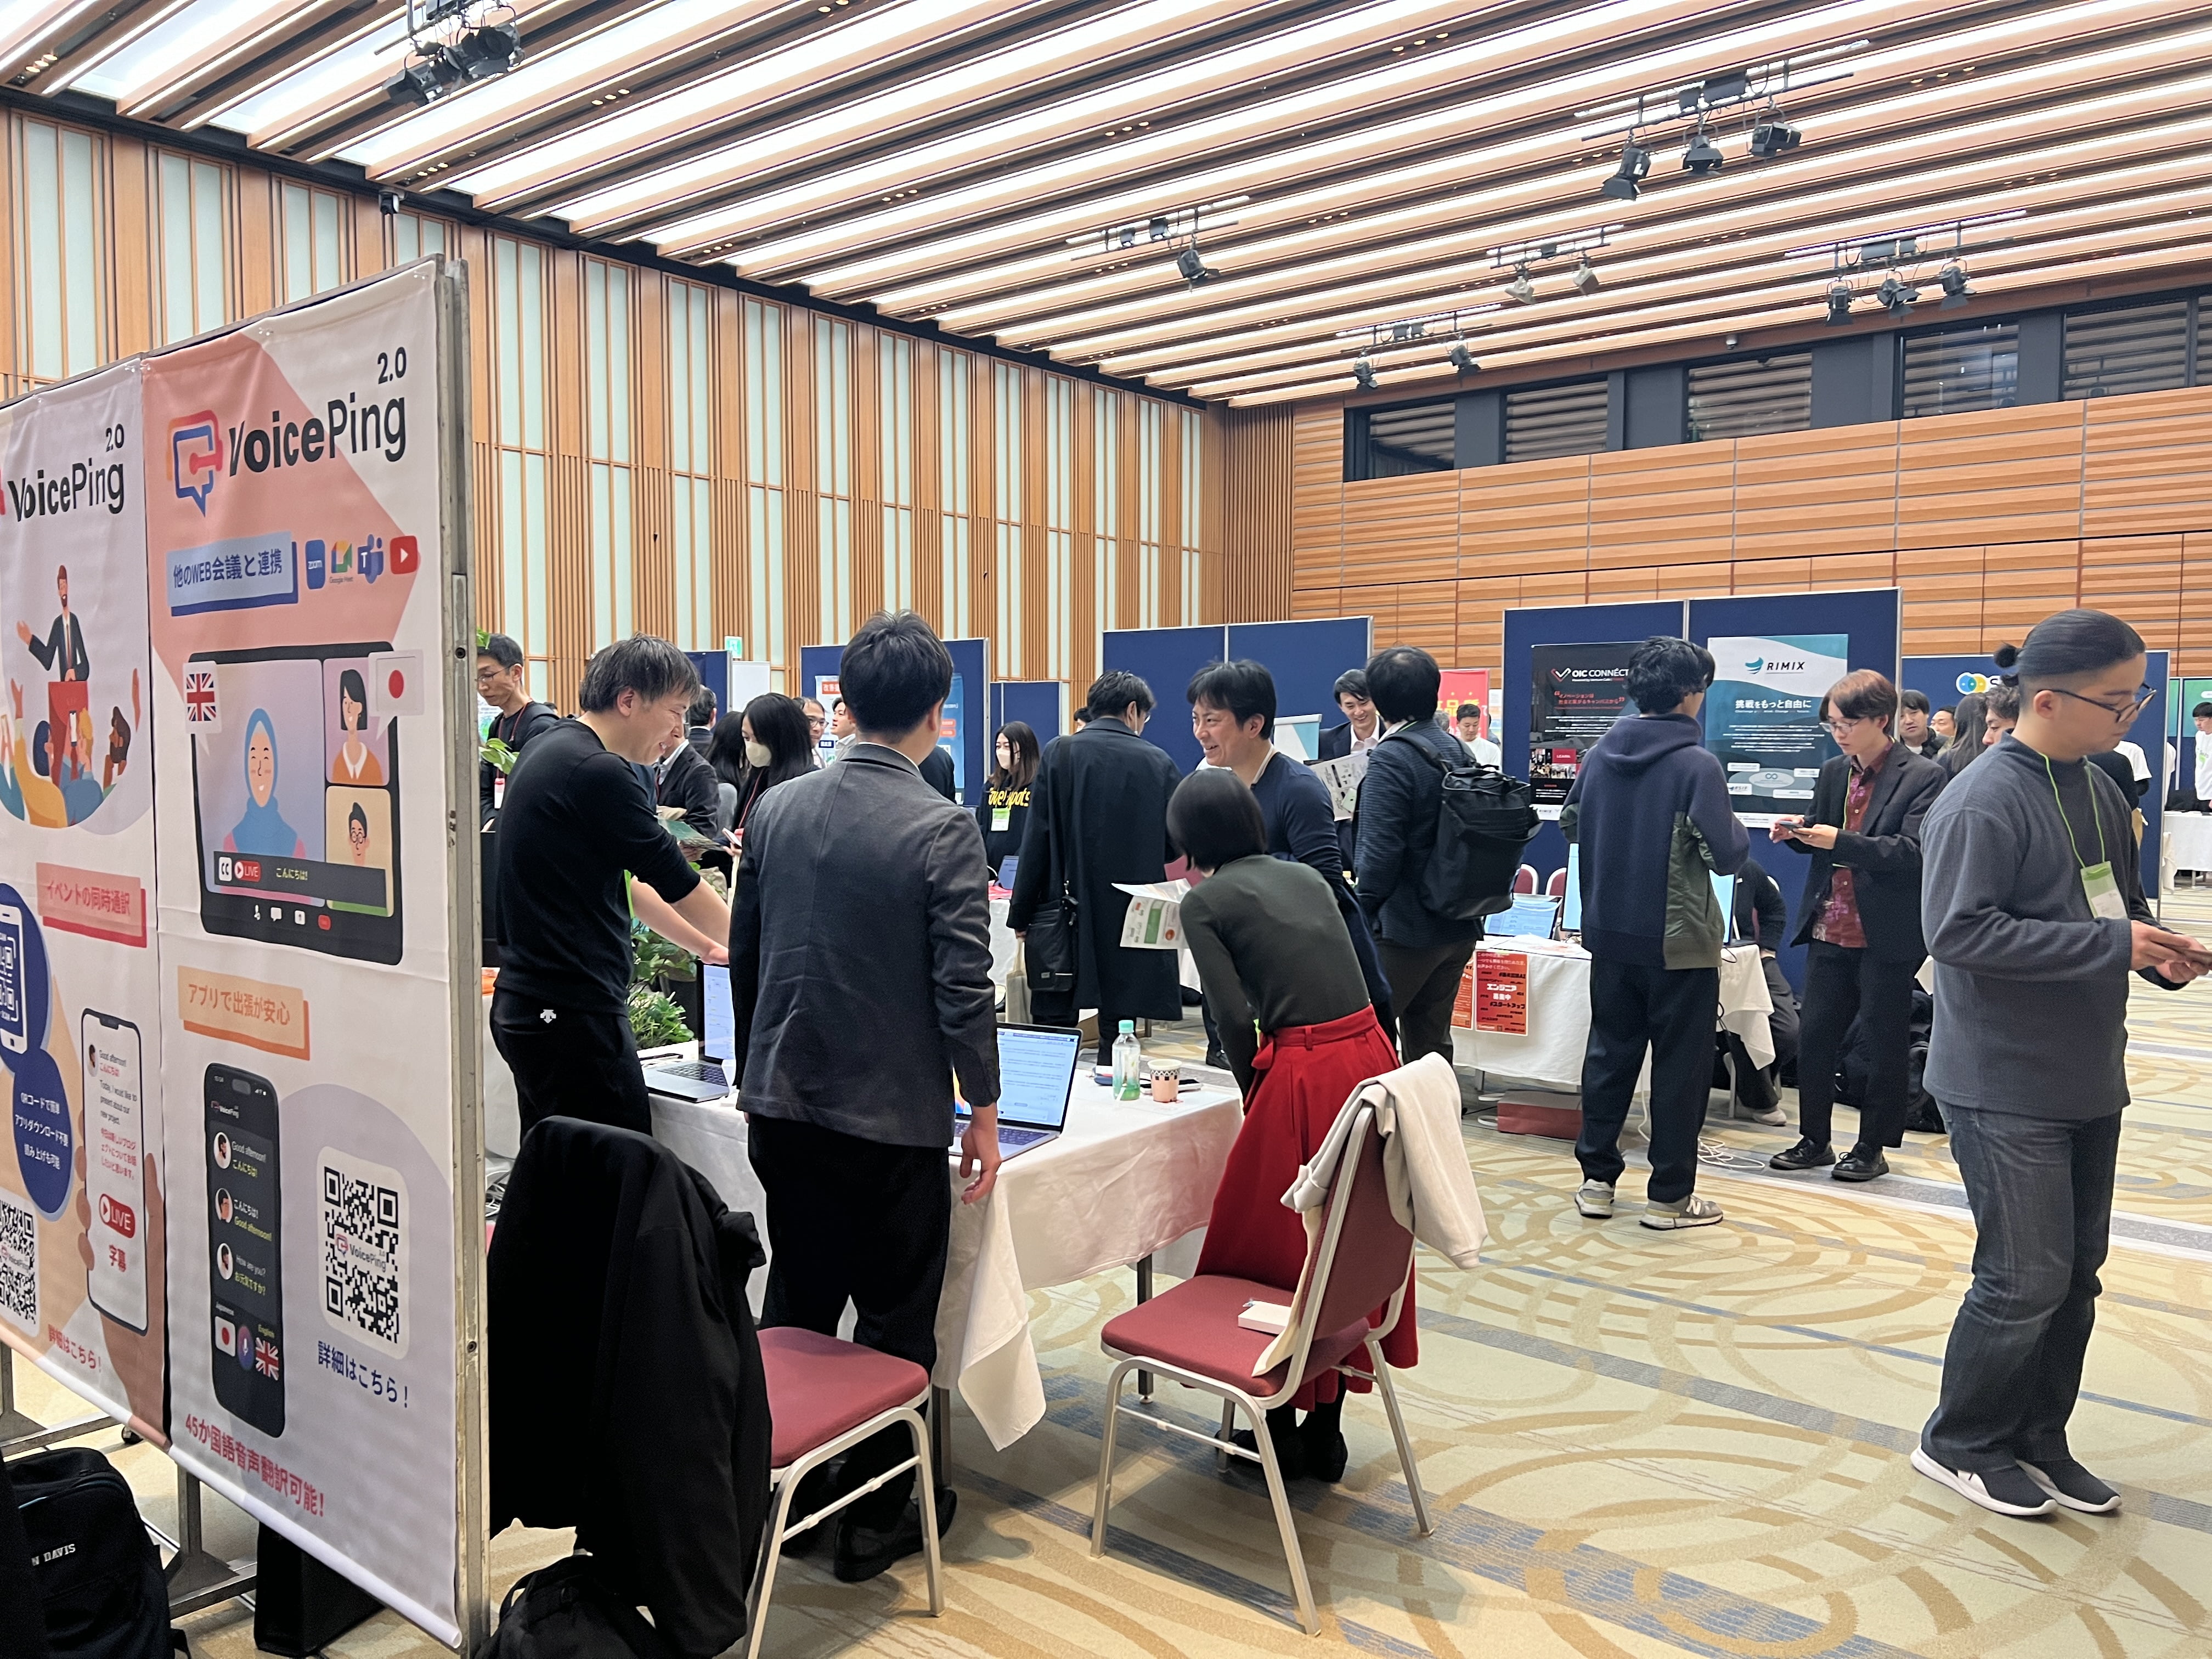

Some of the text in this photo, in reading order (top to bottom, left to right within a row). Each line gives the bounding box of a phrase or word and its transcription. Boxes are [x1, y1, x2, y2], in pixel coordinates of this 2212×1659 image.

[377, 346, 407, 385] 2.0
[105, 424, 124, 452] 2.0
[229, 392, 406, 477] VoicePing
[7, 458, 125, 522] VoicePing
[173, 548, 283, 589] 他のWEB会議と連携
[1767, 662, 1805, 670] RIMIX
[1735, 699, 1812, 709] 挑戦をもっと自由に
[244, 866, 259, 877] LIVE
[47, 880, 131, 916] イベントの同時通訳
[1487, 983, 1517, 992] エンジニア
[188, 983, 291, 1026] アプリで出張が安心
[110, 1209, 132, 1231] LIVE
[109, 1244, 126, 1273] 字幕
[349, 1243, 386, 1273] VoicePing
[43, 1543, 76, 1562] DAVIS
